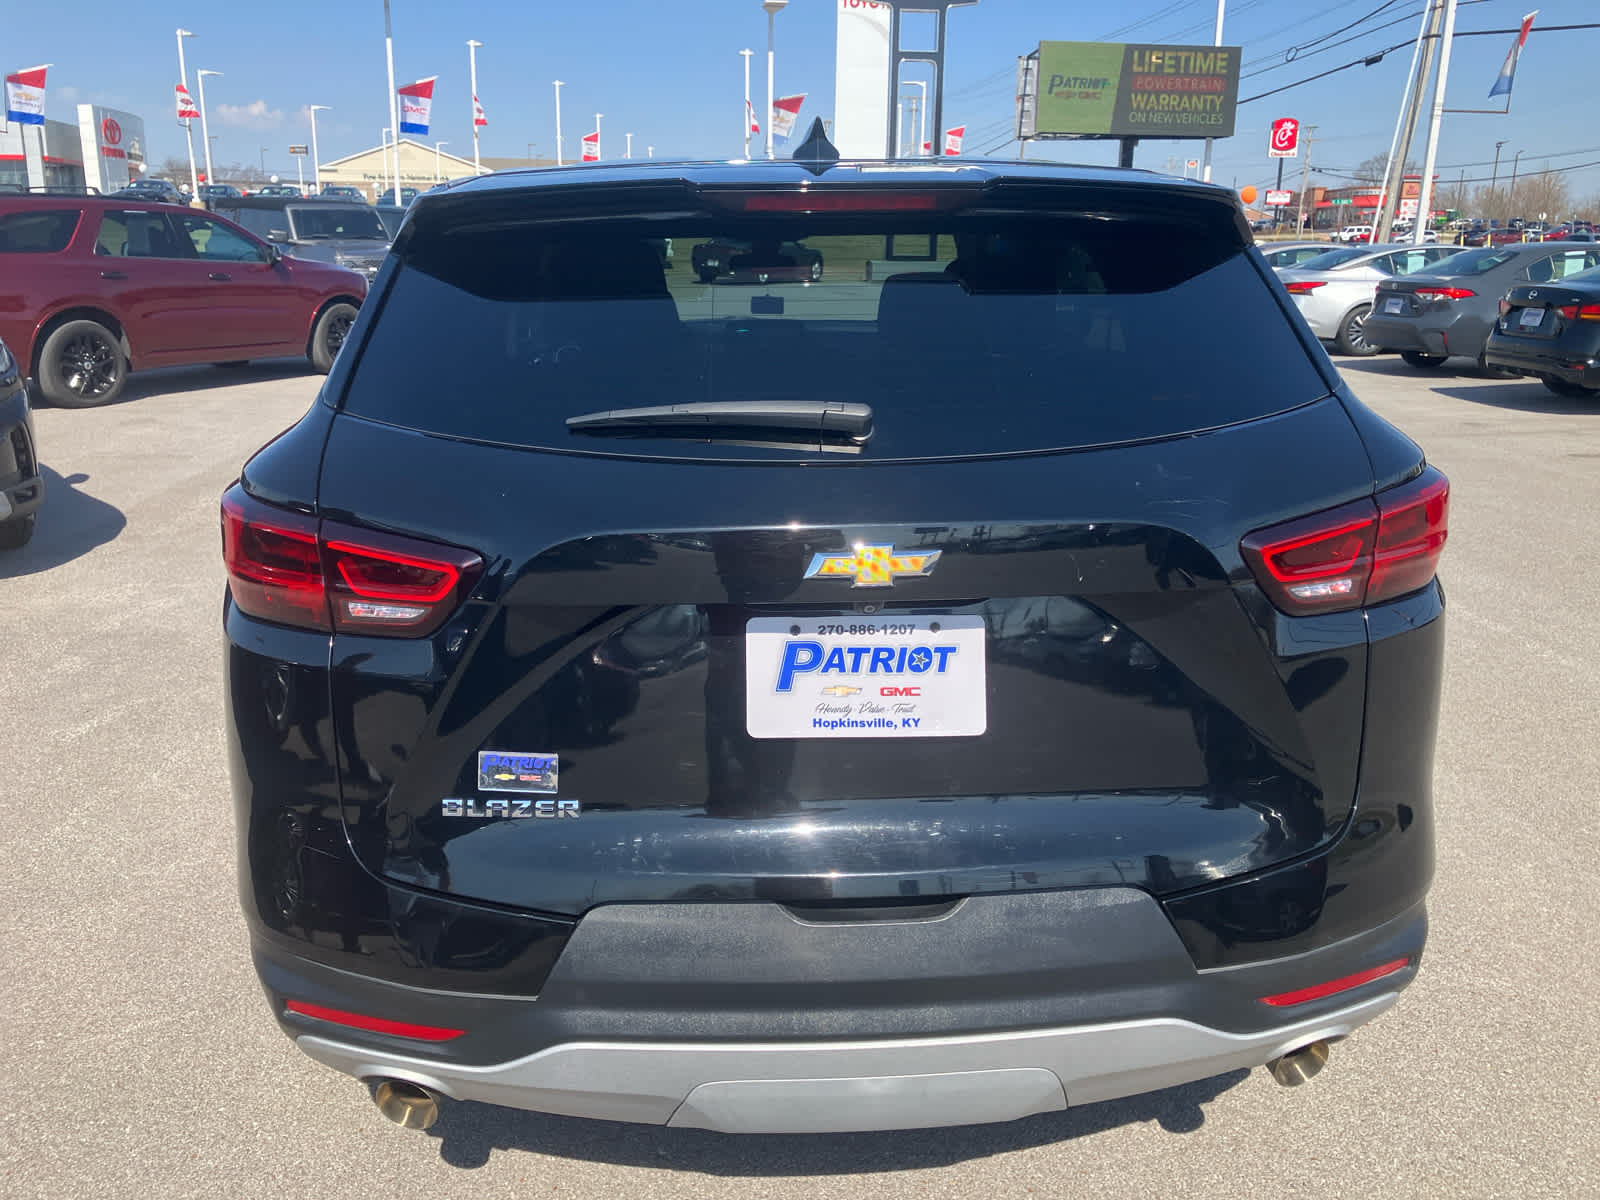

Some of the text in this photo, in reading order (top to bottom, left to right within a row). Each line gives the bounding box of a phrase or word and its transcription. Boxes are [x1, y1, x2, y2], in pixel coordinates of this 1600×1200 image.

[1132, 50, 1229, 74] LIFETIME
[1136, 77, 1223, 90] POWERTRAIN
[1131, 93, 1224, 112] WARRANTY
[1129, 112, 1224, 125] ON NEW VEHICLES
[818, 624, 916, 636] 270-886-1207
[776, 640, 958, 692] PATRIOT
[880, 686, 921, 696] GMC
[812, 718, 921, 729] Hopkinsville, KY
[481, 753, 556, 773] PATRIOT
[442, 799, 580, 818] BLAZER
